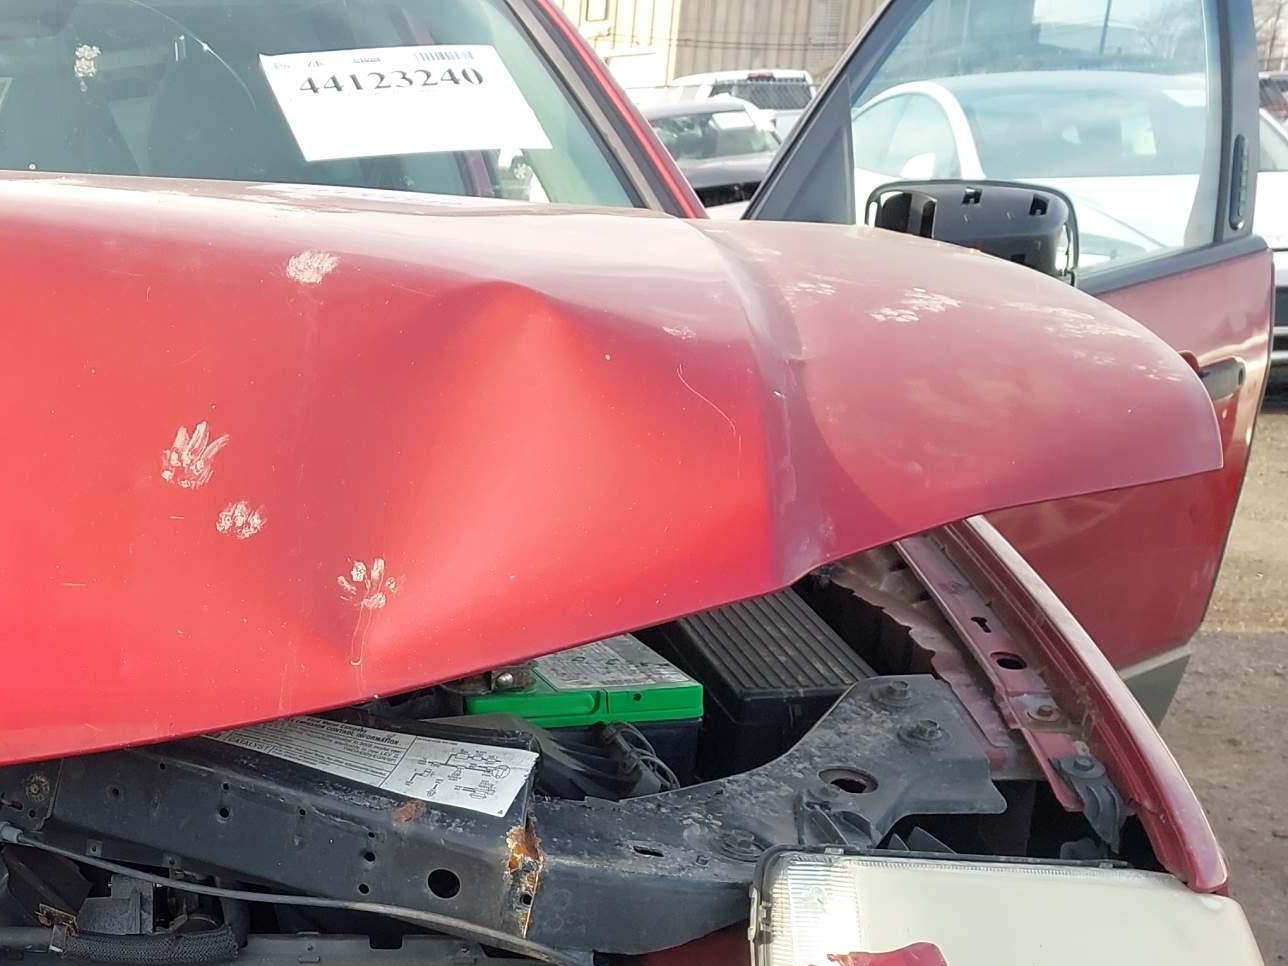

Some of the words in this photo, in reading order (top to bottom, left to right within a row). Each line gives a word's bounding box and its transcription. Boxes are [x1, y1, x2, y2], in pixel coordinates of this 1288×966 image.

[300, 67, 484, 94] 44123240
[326, 725, 354, 738] CONTROL
[355, 732, 400, 746] INFORMATION
